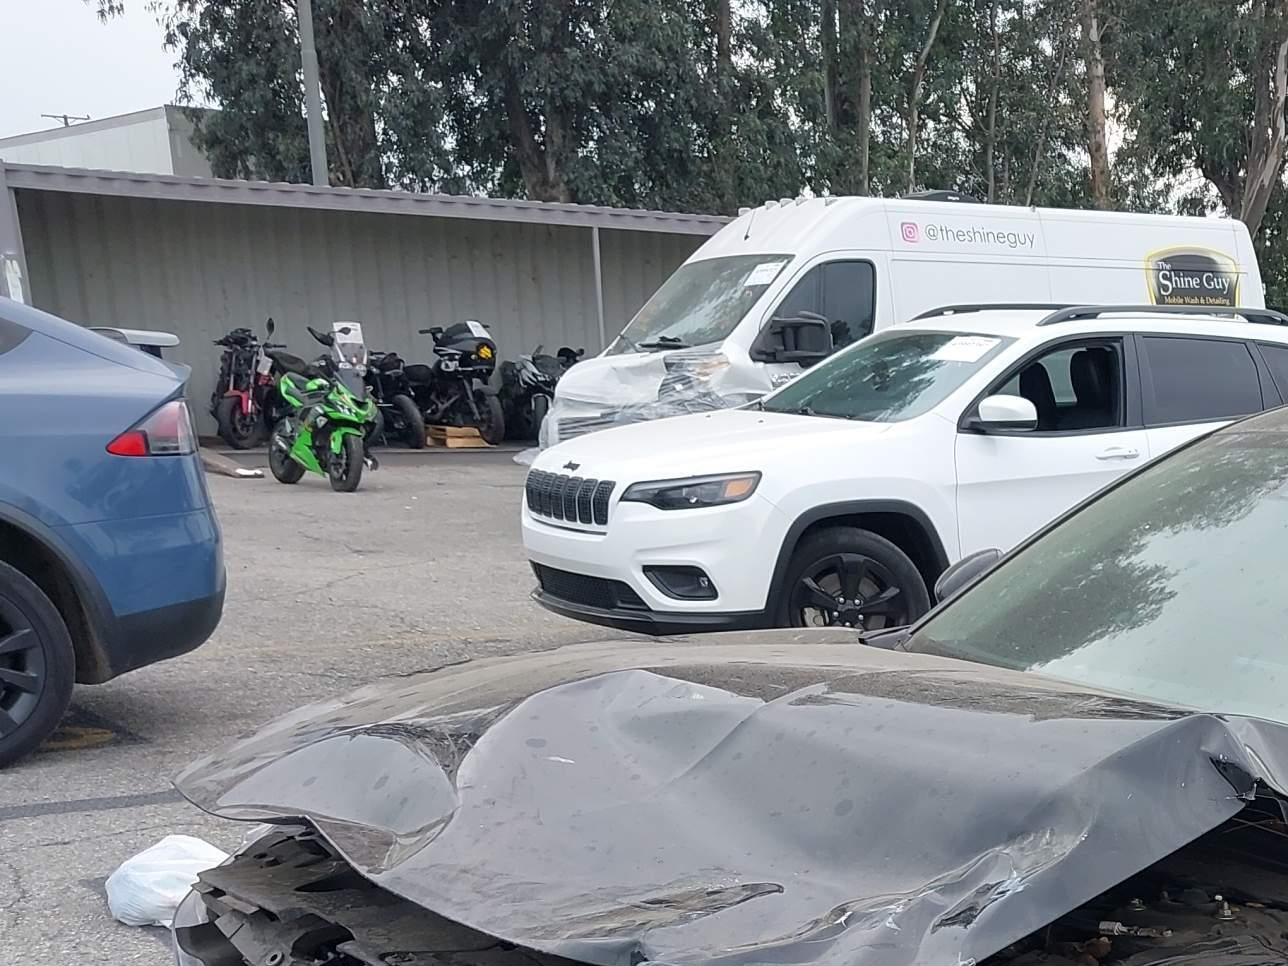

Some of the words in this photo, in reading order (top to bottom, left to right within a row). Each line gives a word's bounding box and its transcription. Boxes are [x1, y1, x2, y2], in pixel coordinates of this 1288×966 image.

[924, 224, 1035, 249] @theshineguy
[1158, 261, 1172, 270] The
[1158, 270, 1201, 296] Shine
[1202, 272, 1230, 295] Guy
[1164, 296, 1184, 304] Mobile
[1184, 296, 1200, 305] Wash
